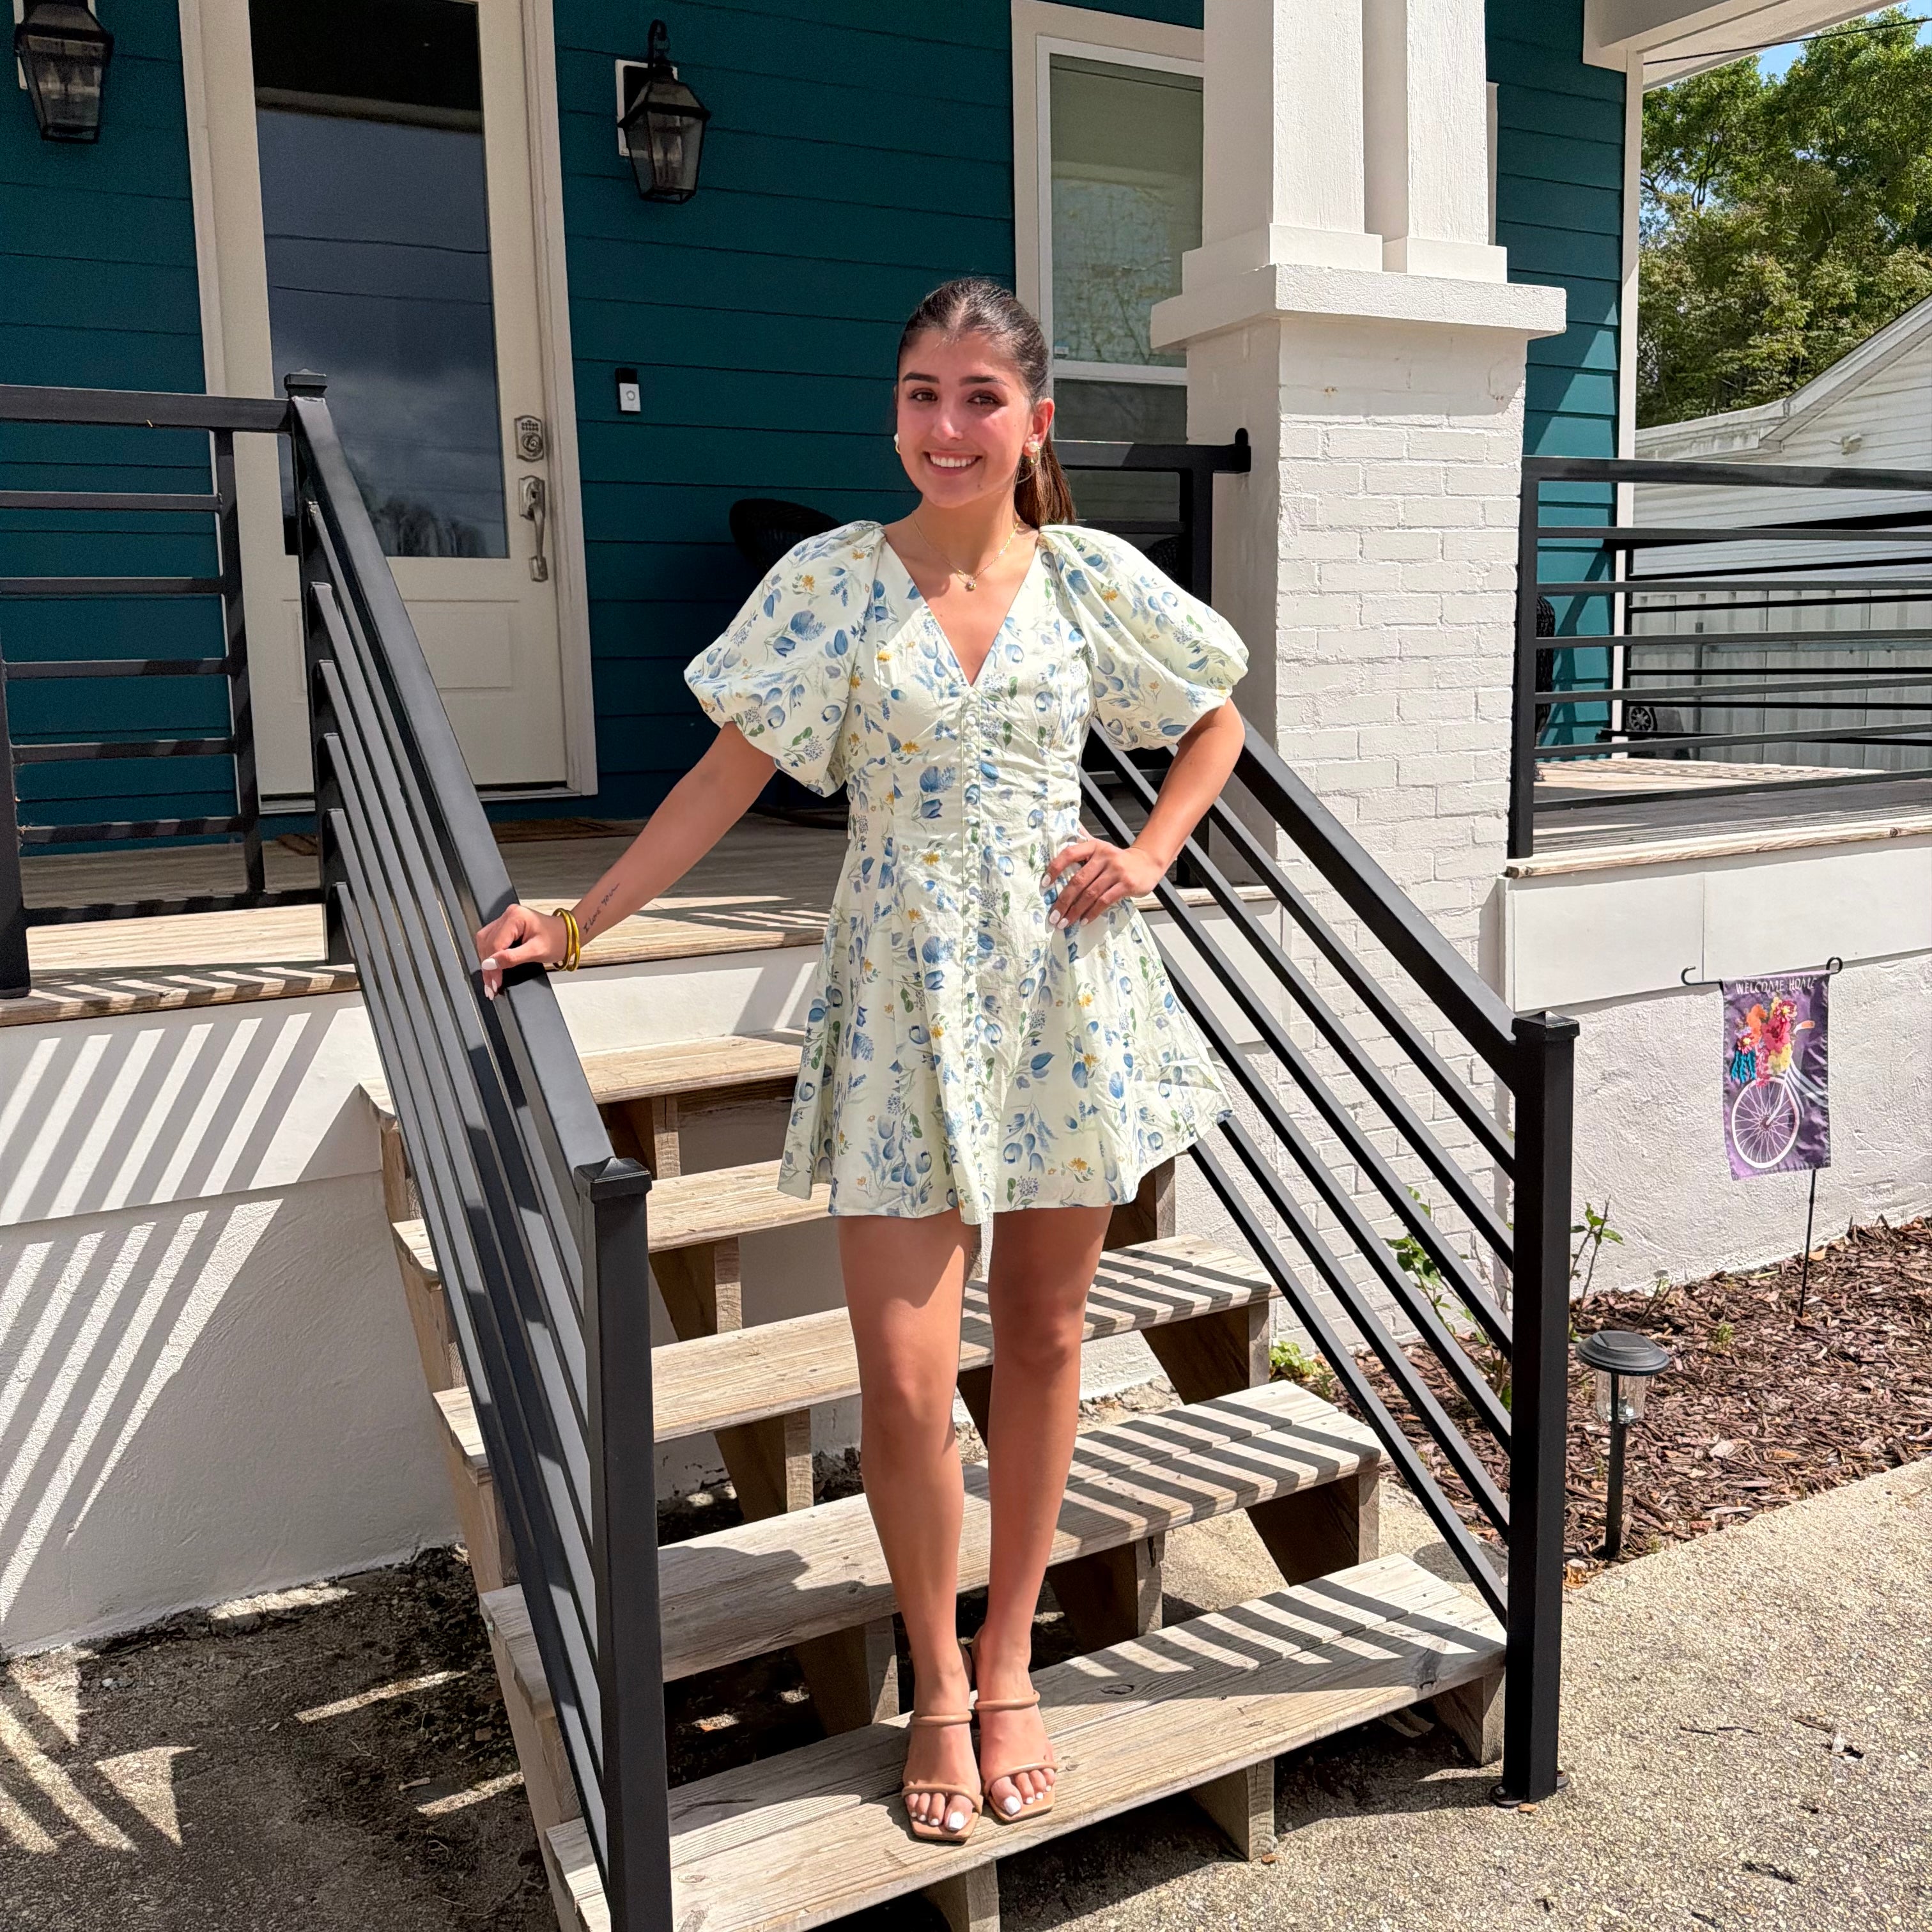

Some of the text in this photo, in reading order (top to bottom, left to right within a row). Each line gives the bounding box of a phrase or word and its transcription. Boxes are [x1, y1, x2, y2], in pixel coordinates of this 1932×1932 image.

[583, 922, 589, 934] I
[1735, 977, 1817, 995] WELCOME HOME
